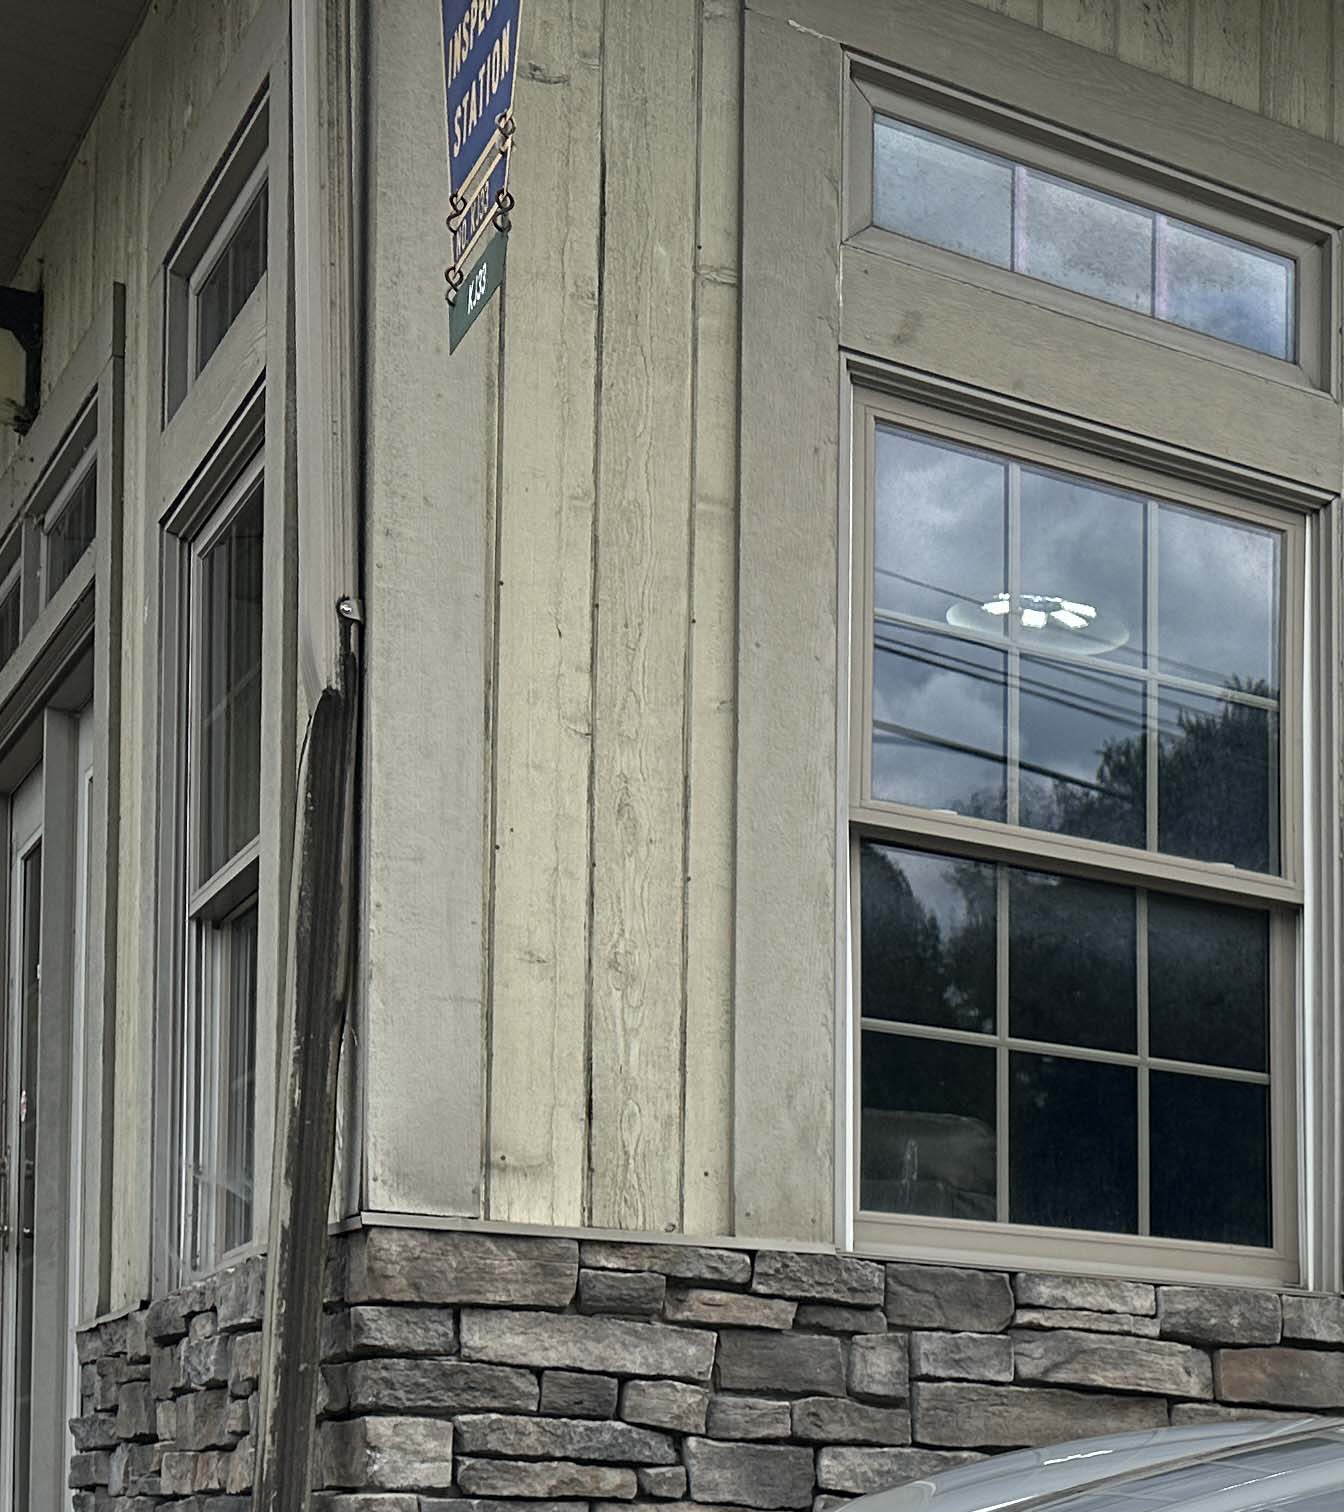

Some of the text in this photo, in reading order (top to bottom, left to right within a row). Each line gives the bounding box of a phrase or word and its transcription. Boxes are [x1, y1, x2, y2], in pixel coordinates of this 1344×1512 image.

[447, 0, 499, 89] INSPE
[453, 19, 511, 158] STATION
[467, 262, 487, 315] KJ33
